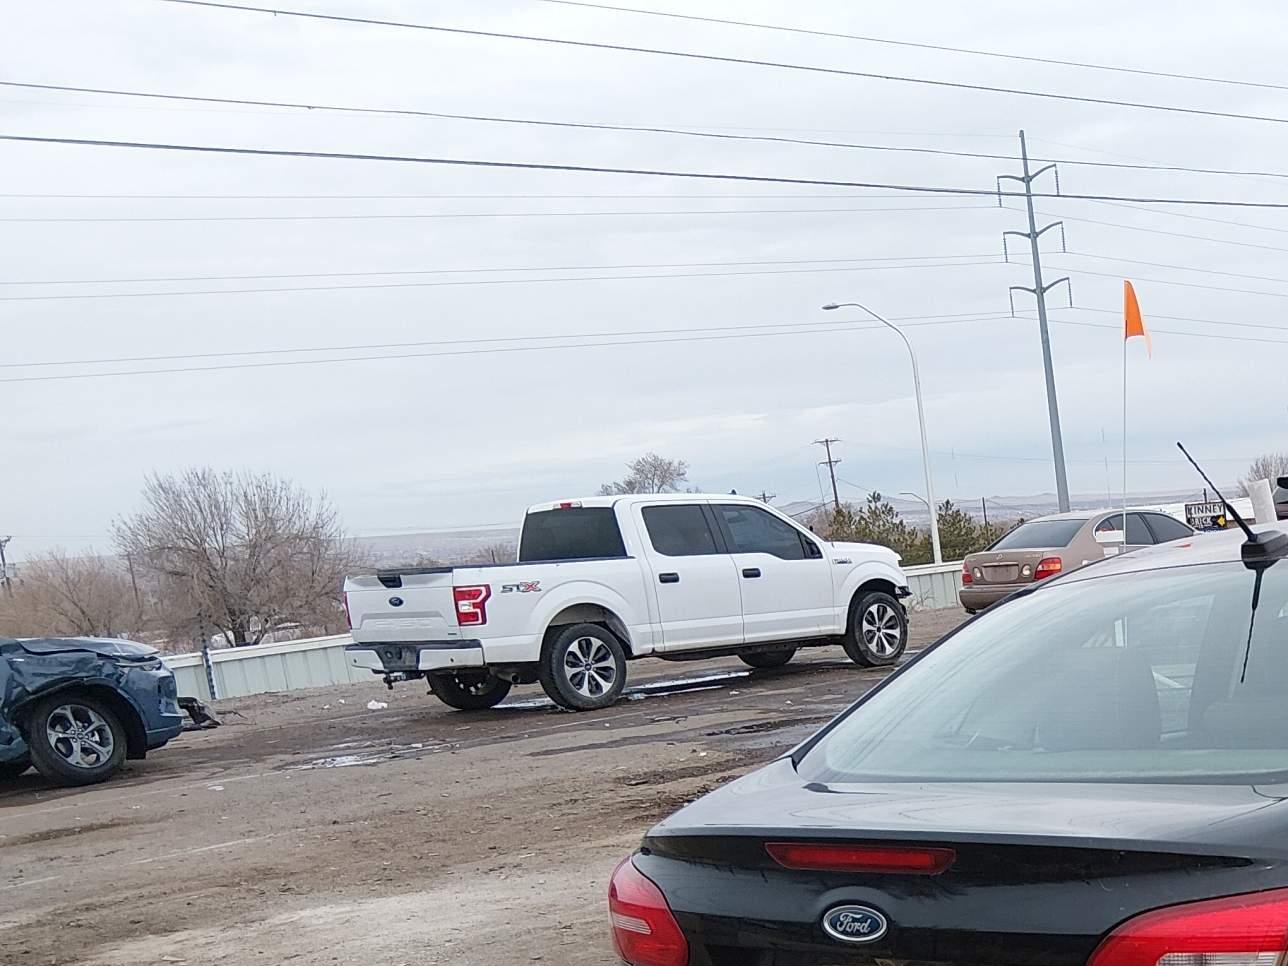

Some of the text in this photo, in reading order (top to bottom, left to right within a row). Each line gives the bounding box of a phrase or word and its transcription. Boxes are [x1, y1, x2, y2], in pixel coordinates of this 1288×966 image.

[1187, 504, 1222, 515] KINNEY
[500, 580, 543, 594] STX
[837, 912, 871, 933] Ford
